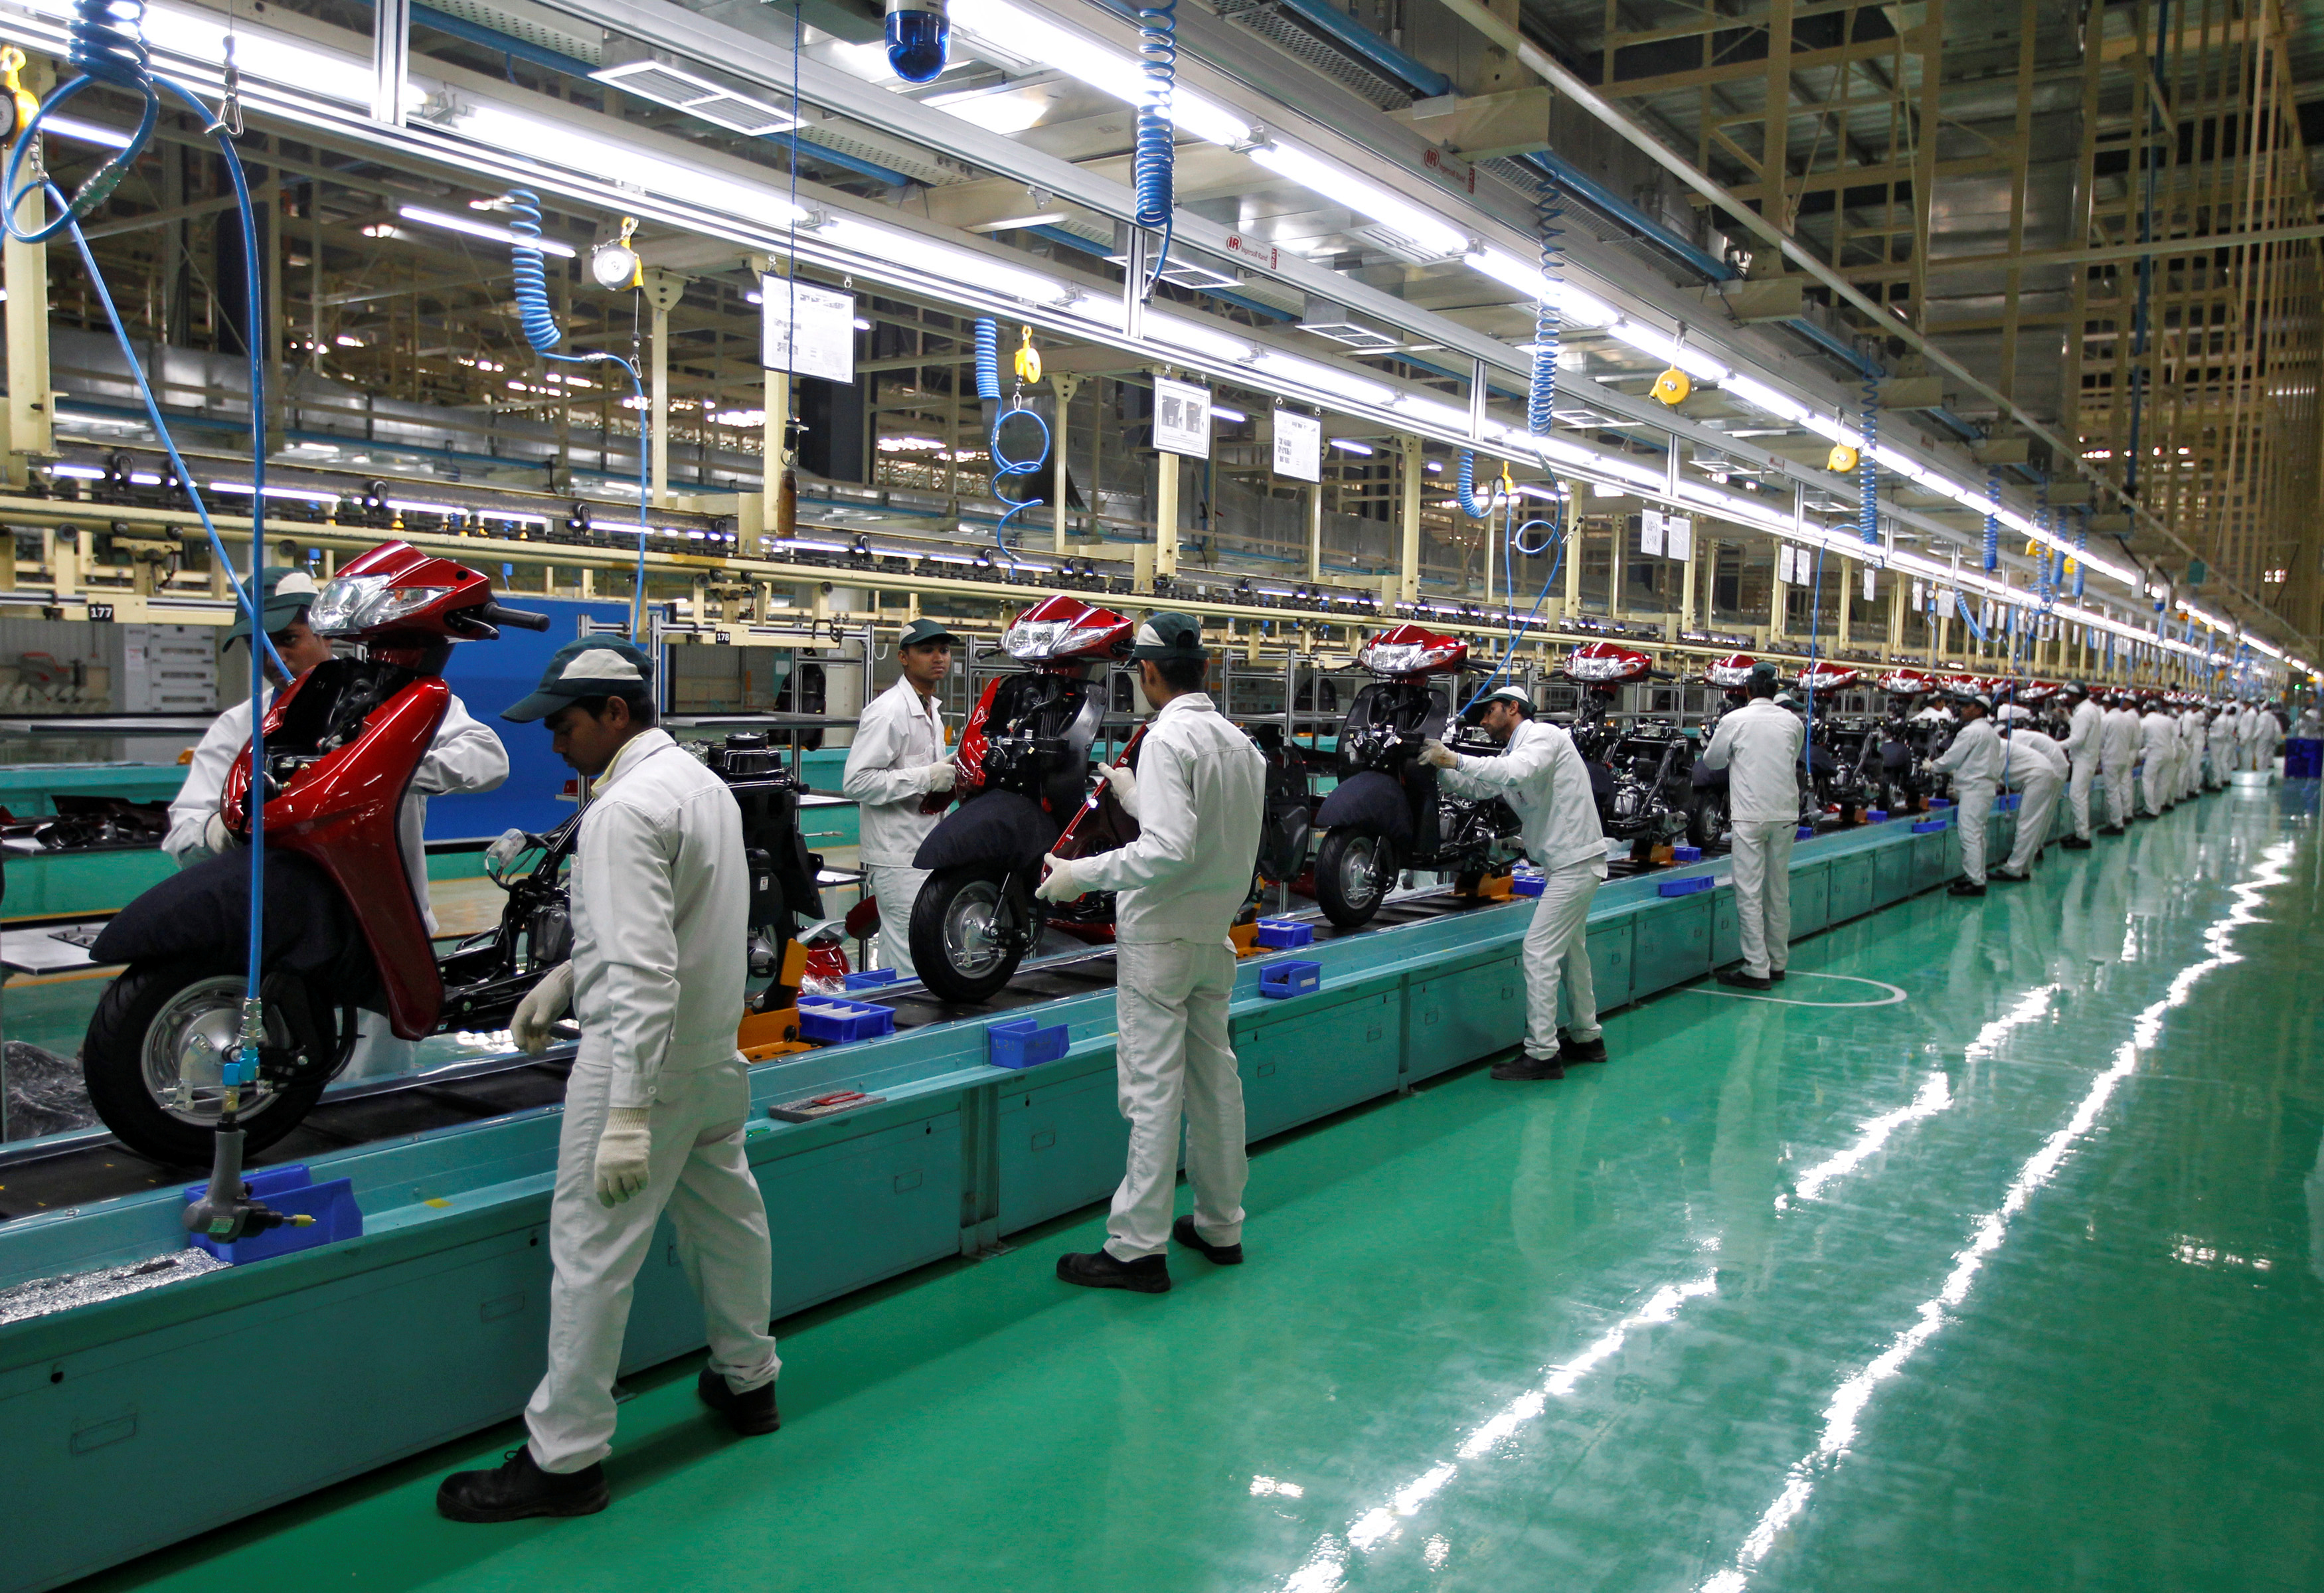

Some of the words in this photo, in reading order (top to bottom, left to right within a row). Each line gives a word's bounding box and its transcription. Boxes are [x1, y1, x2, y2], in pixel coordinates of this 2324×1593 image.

[1426, 149, 1438, 167] IR
[1228, 236, 1240, 251] IR
[1241, 246, 1258, 258] Ingersoll
[1258, 252, 1268, 262] Rand
[90, 607, 113, 618] 177
[716, 633, 730, 641] 178
